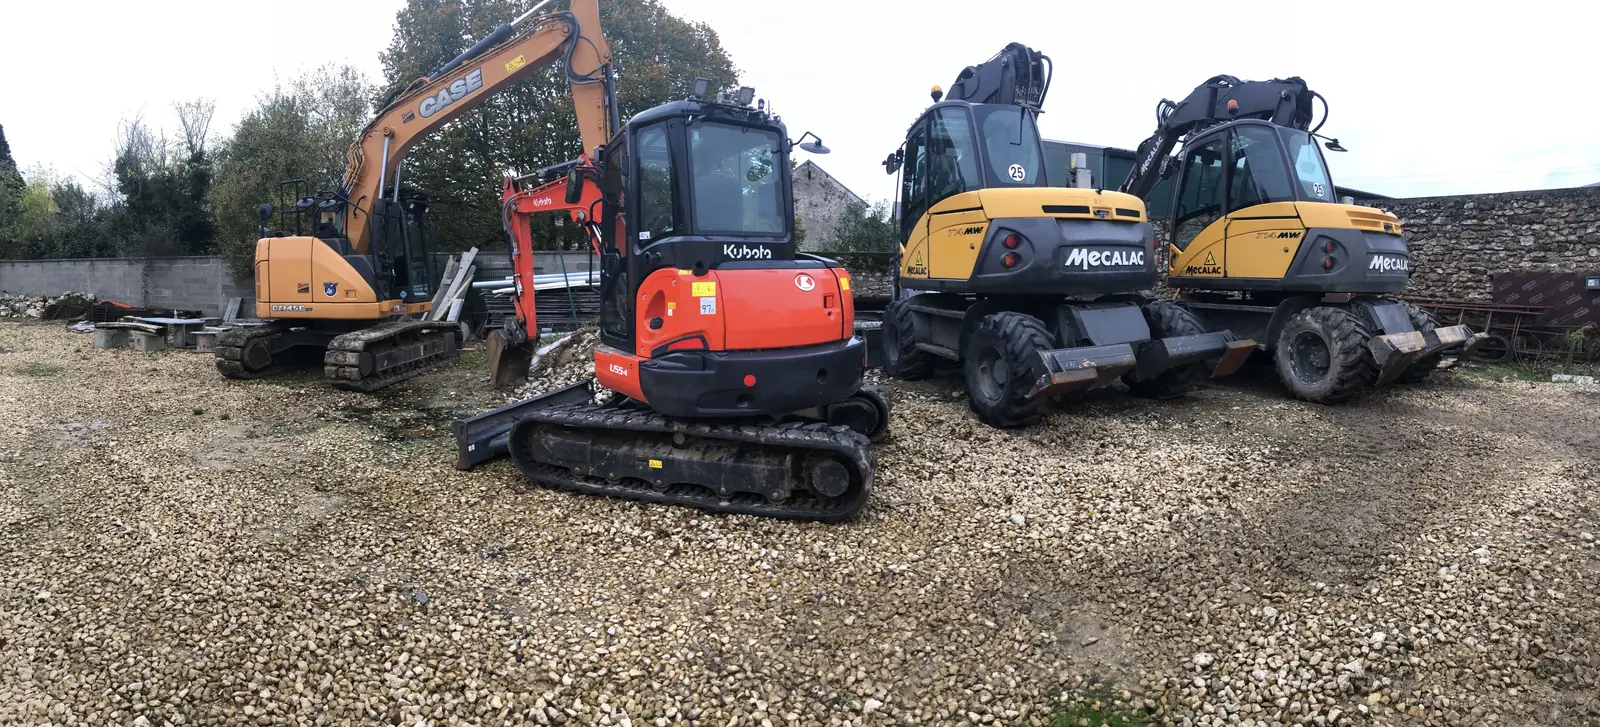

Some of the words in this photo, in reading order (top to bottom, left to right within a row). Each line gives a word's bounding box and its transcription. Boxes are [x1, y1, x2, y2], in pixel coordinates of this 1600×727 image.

[418, 67, 483, 118] CASE
[1010, 166, 1024, 179] 25
[1314, 184, 1323, 195] 25
[723, 244, 772, 259] Kubota
[701, 304, 712, 313] 97
